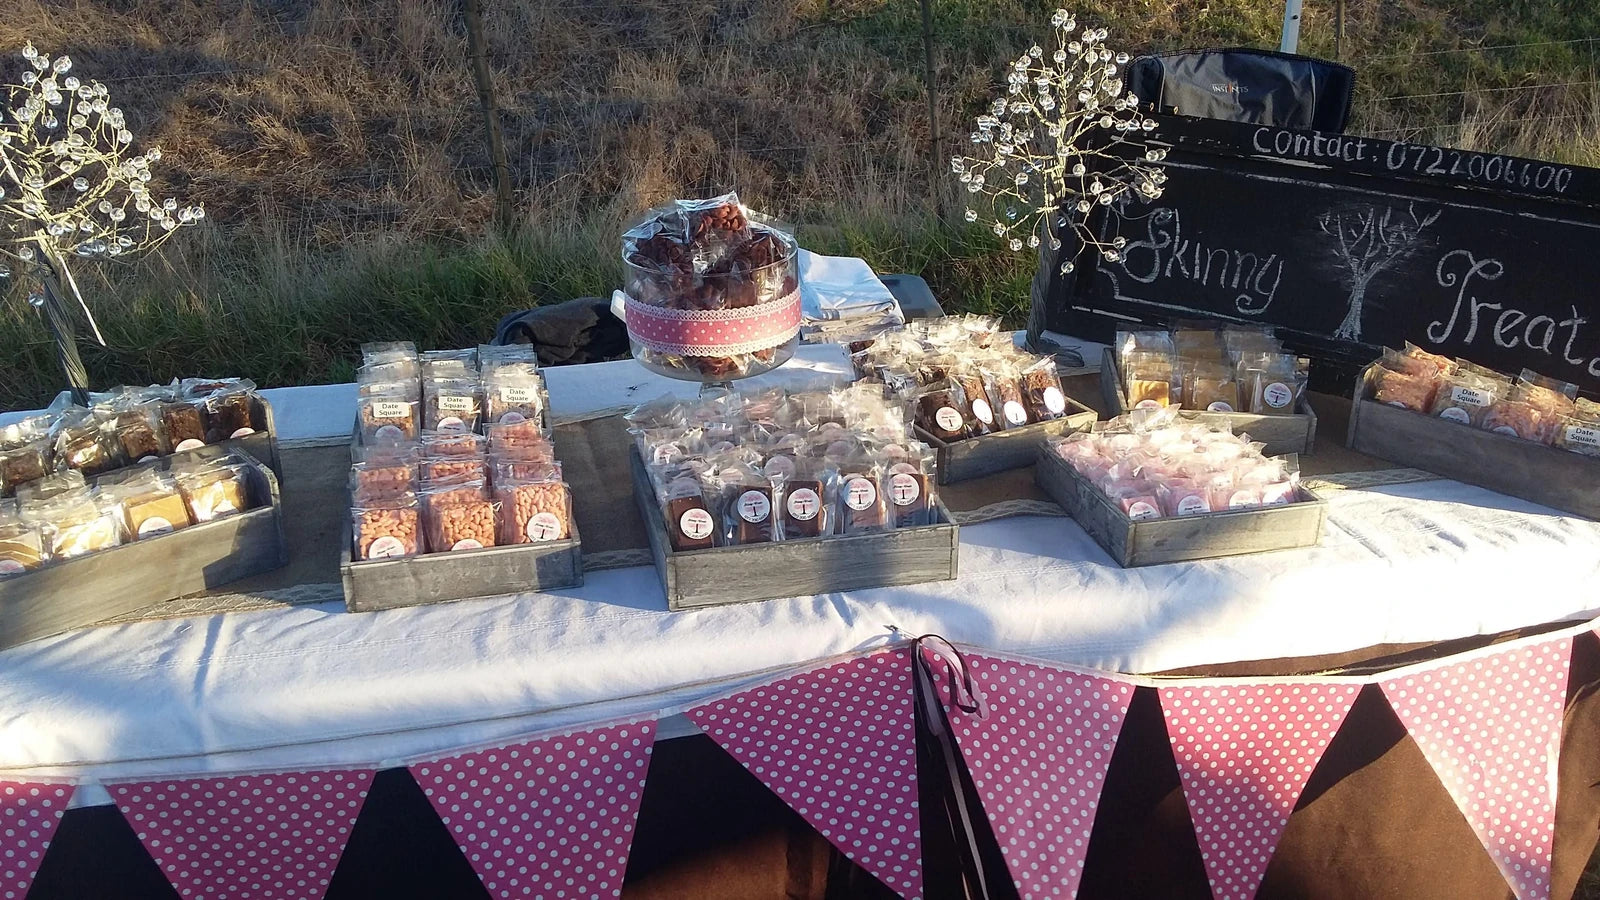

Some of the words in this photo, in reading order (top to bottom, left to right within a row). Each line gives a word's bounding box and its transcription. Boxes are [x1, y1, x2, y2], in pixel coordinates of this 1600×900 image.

[1122, 207, 1285, 315] Skinny
[509, 388, 526, 396] Date
[1461, 388, 1480, 398] Date
[505, 394, 529, 402] Square
[1456, 393, 1482, 405] Square
[1575, 427, 1594, 437] Date
[1570, 433, 1597, 444] Square
